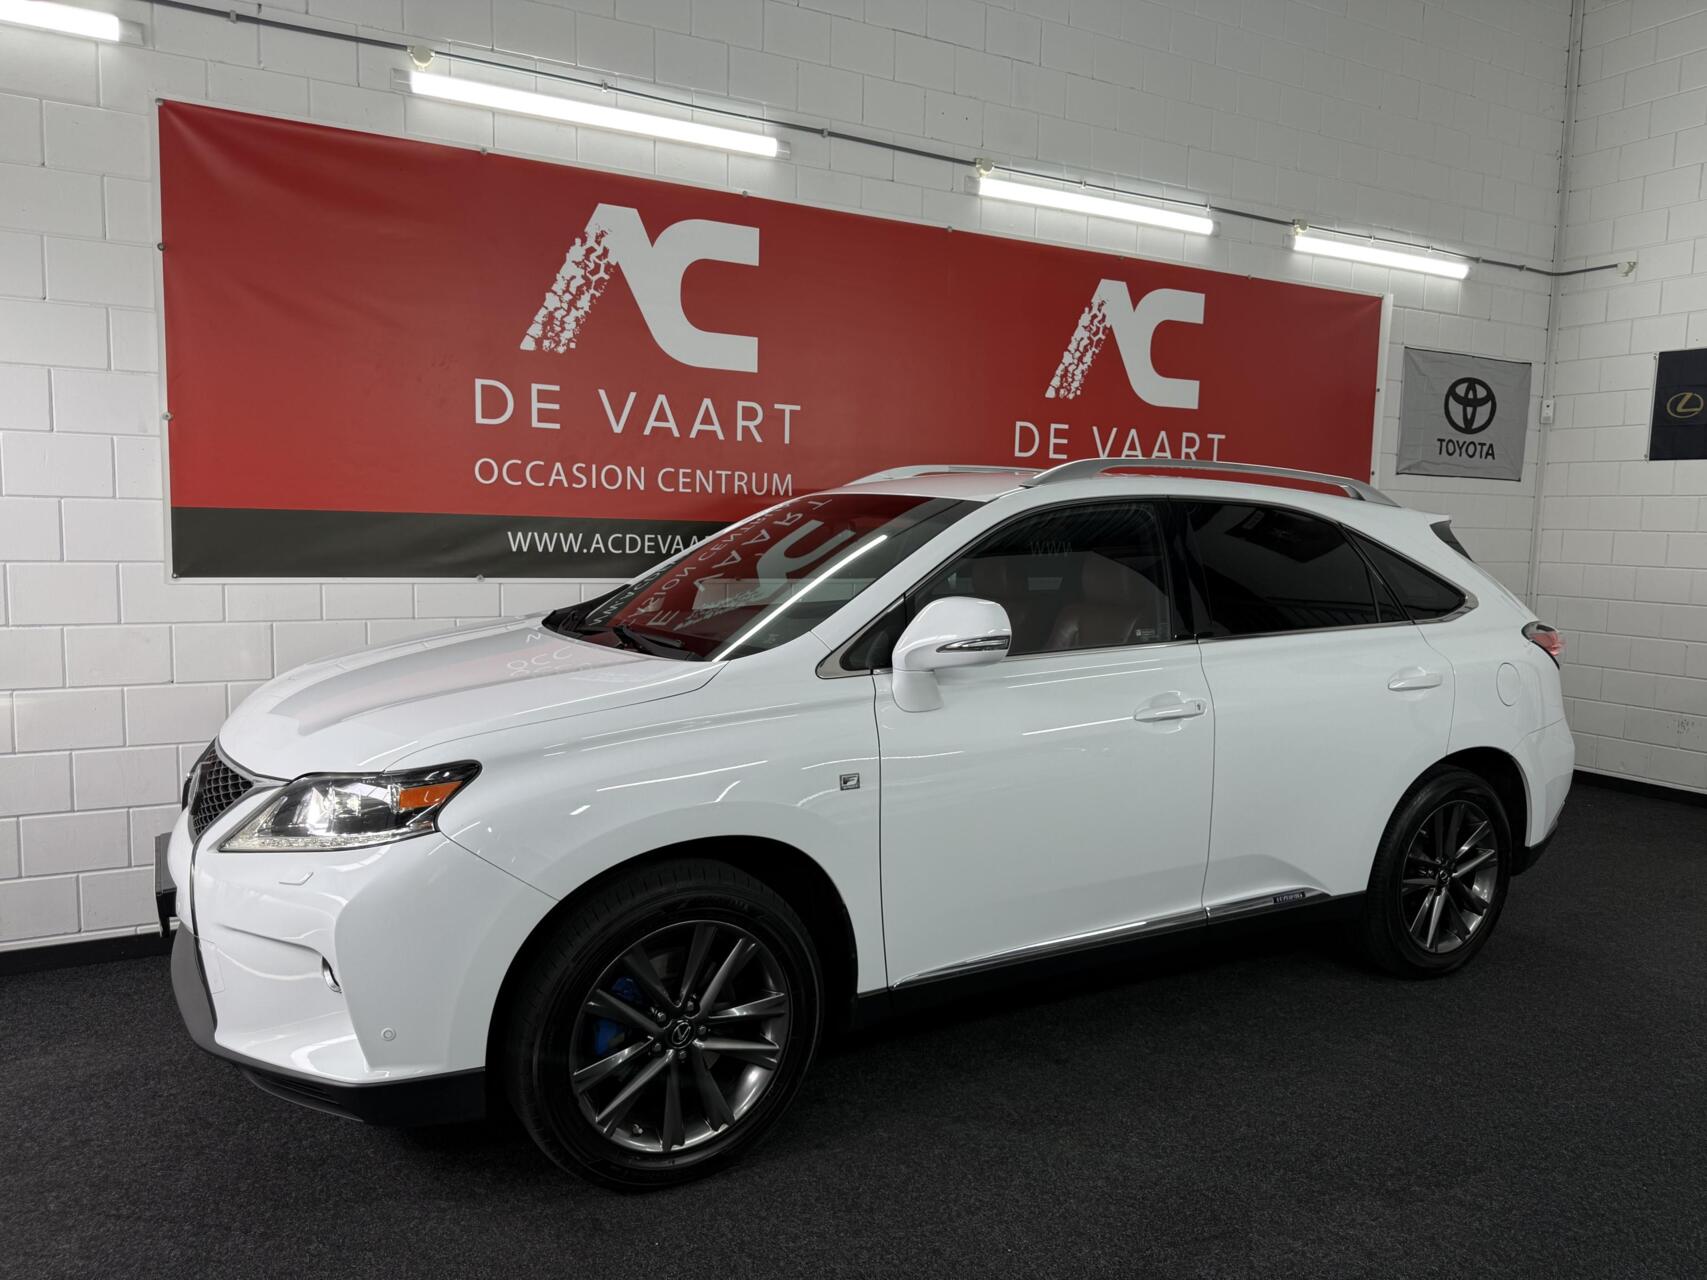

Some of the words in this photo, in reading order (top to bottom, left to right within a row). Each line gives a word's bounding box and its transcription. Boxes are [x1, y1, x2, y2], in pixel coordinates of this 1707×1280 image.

[519, 202, 760, 373] AC
[1045, 278, 1205, 410] AC
[474, 377, 561, 430] DE
[598, 389, 801, 444] VAART
[1014, 420, 1070, 460] DE
[1092, 426, 1226, 462] VAART
[1437, 438, 1496, 460] TOYOTA
[474, 457, 646, 491] OCCASION
[657, 467, 793, 497] CENTRUM
[507, 531, 711, 554] WWW.ACDEVAA
